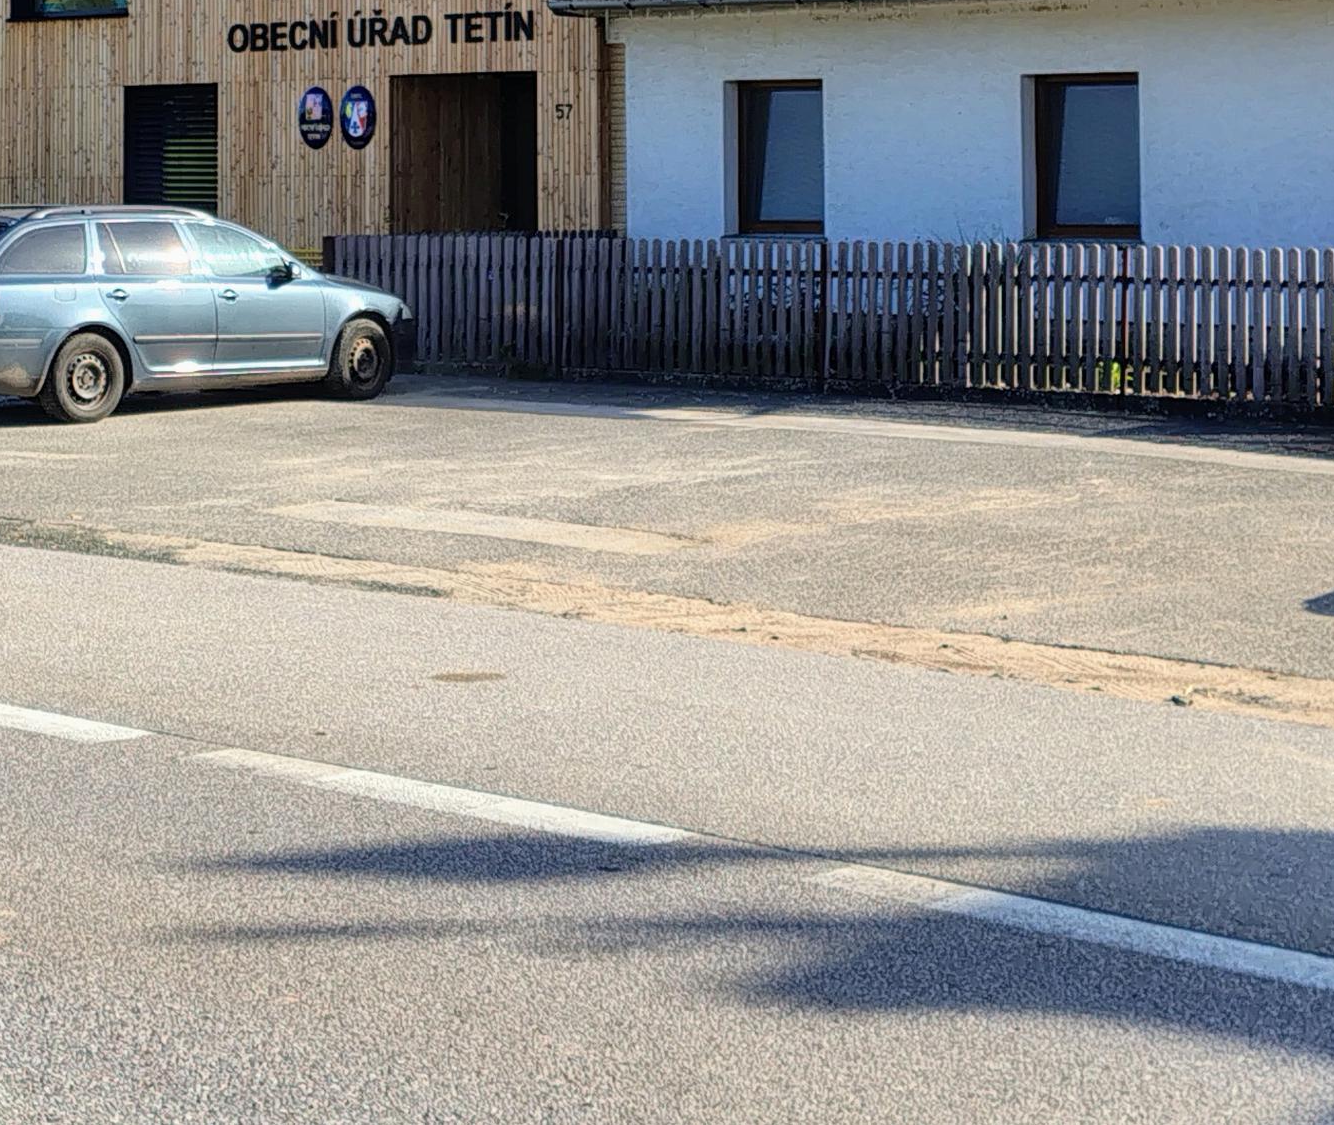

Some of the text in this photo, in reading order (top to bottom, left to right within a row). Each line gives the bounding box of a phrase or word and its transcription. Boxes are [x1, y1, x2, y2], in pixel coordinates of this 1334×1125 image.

[227, 3, 535, 53] OBECNÍ ÚŘAD TETÍN
[555, 104, 573, 119] 57
